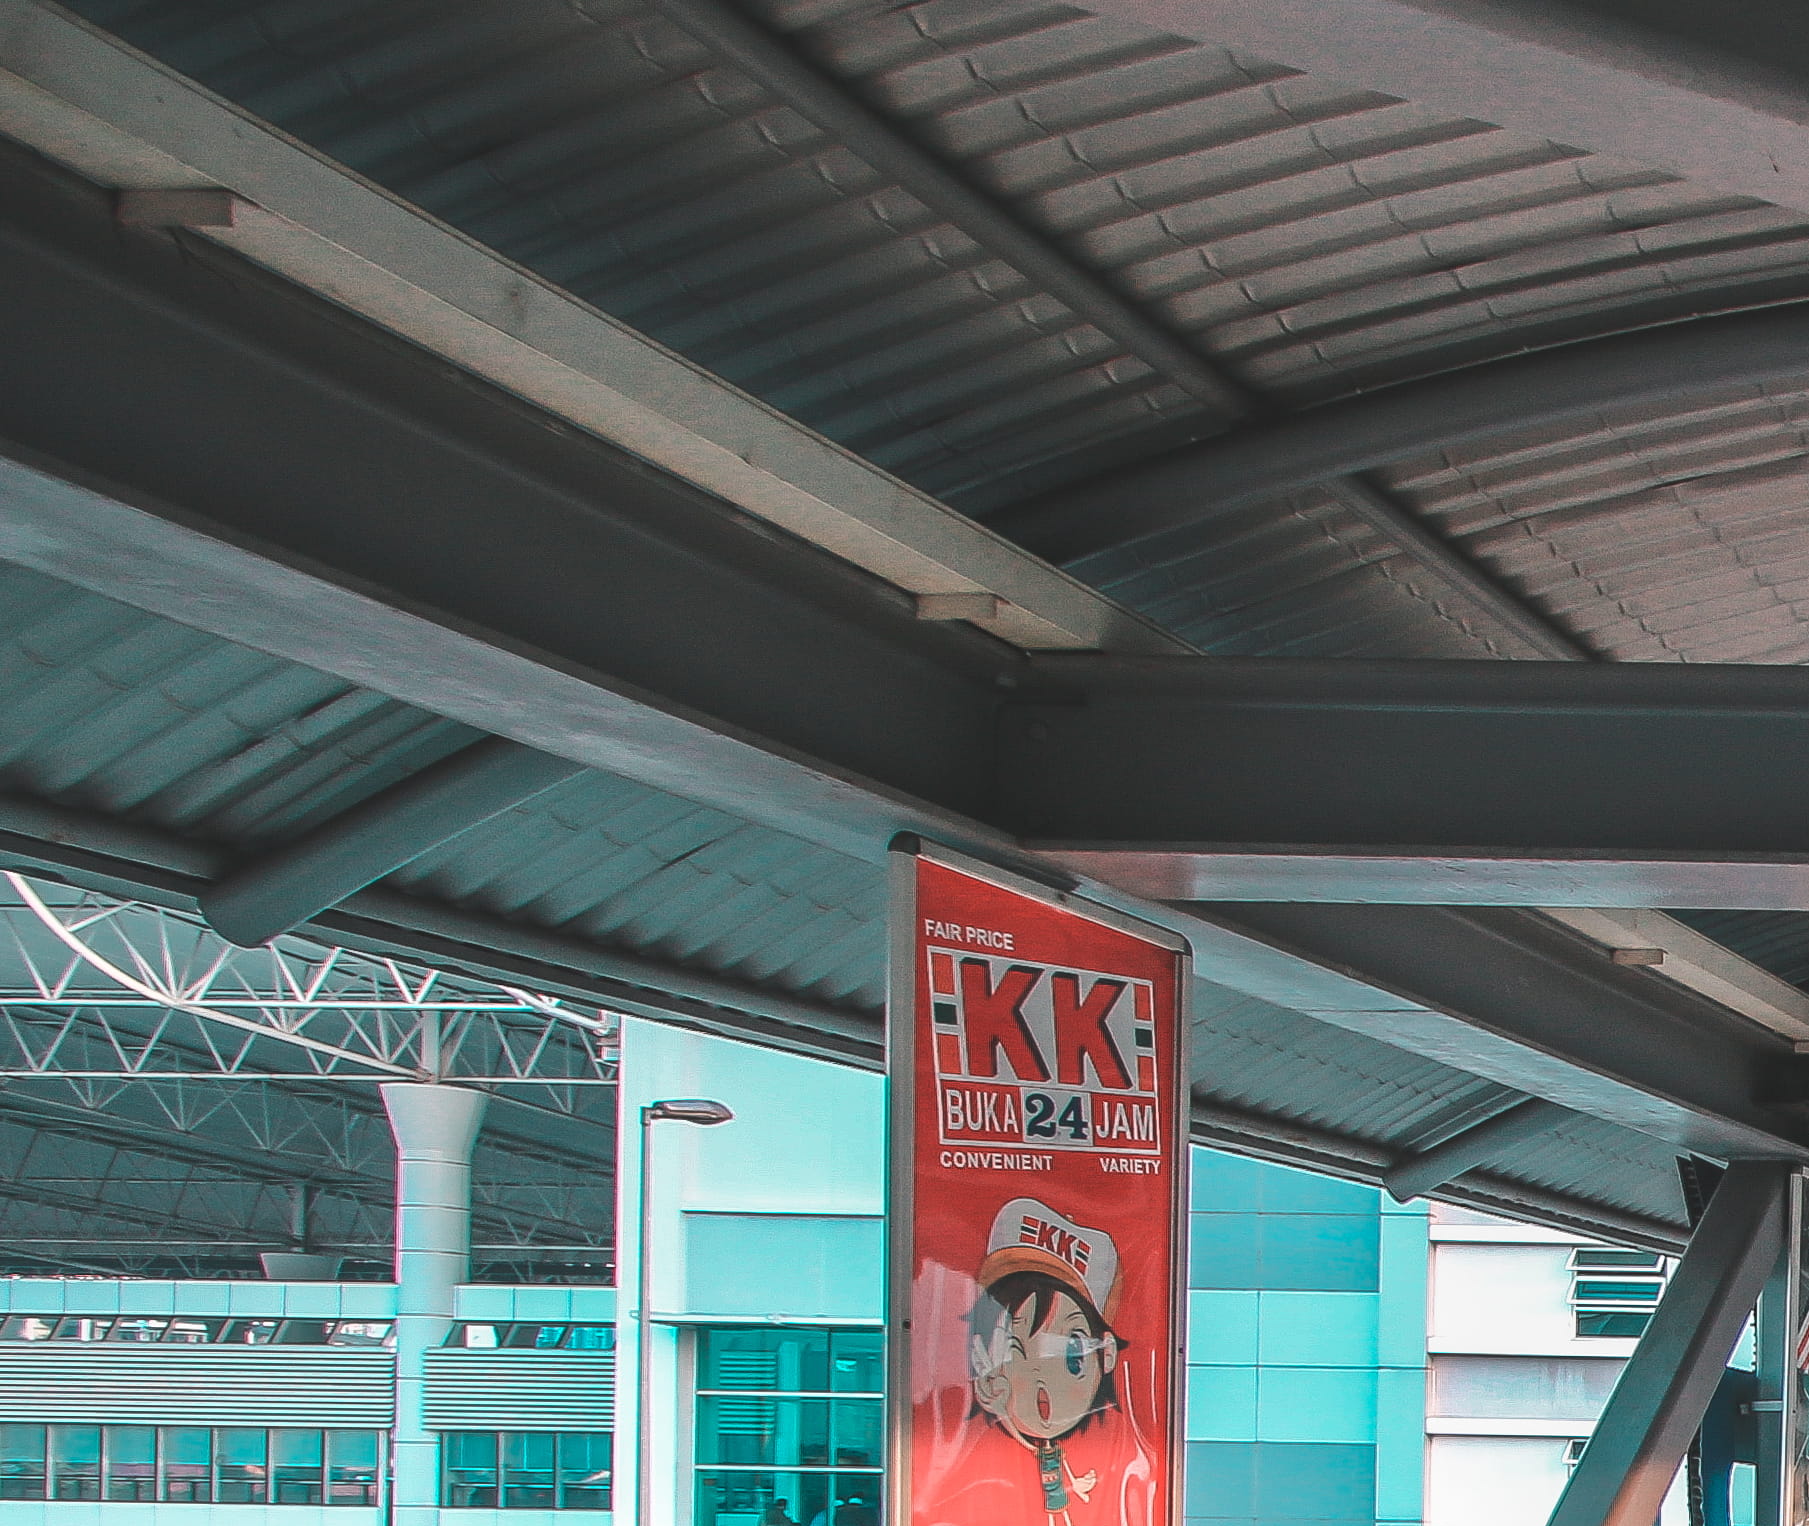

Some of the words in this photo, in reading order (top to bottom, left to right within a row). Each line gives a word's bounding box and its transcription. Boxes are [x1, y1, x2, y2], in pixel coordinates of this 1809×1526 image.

[924, 919, 963, 943] FAIR
[965, 927, 1015, 951] PRICE
[959, 957, 1134, 1090] KK
[947, 1089, 1019, 1133] BUKA
[1024, 1093, 1088, 1140] 24
[1096, 1101, 1155, 1141] JAM
[940, 1151, 1053, 1172] CONVENIENT
[1099, 1157, 1160, 1175] VARIETY
